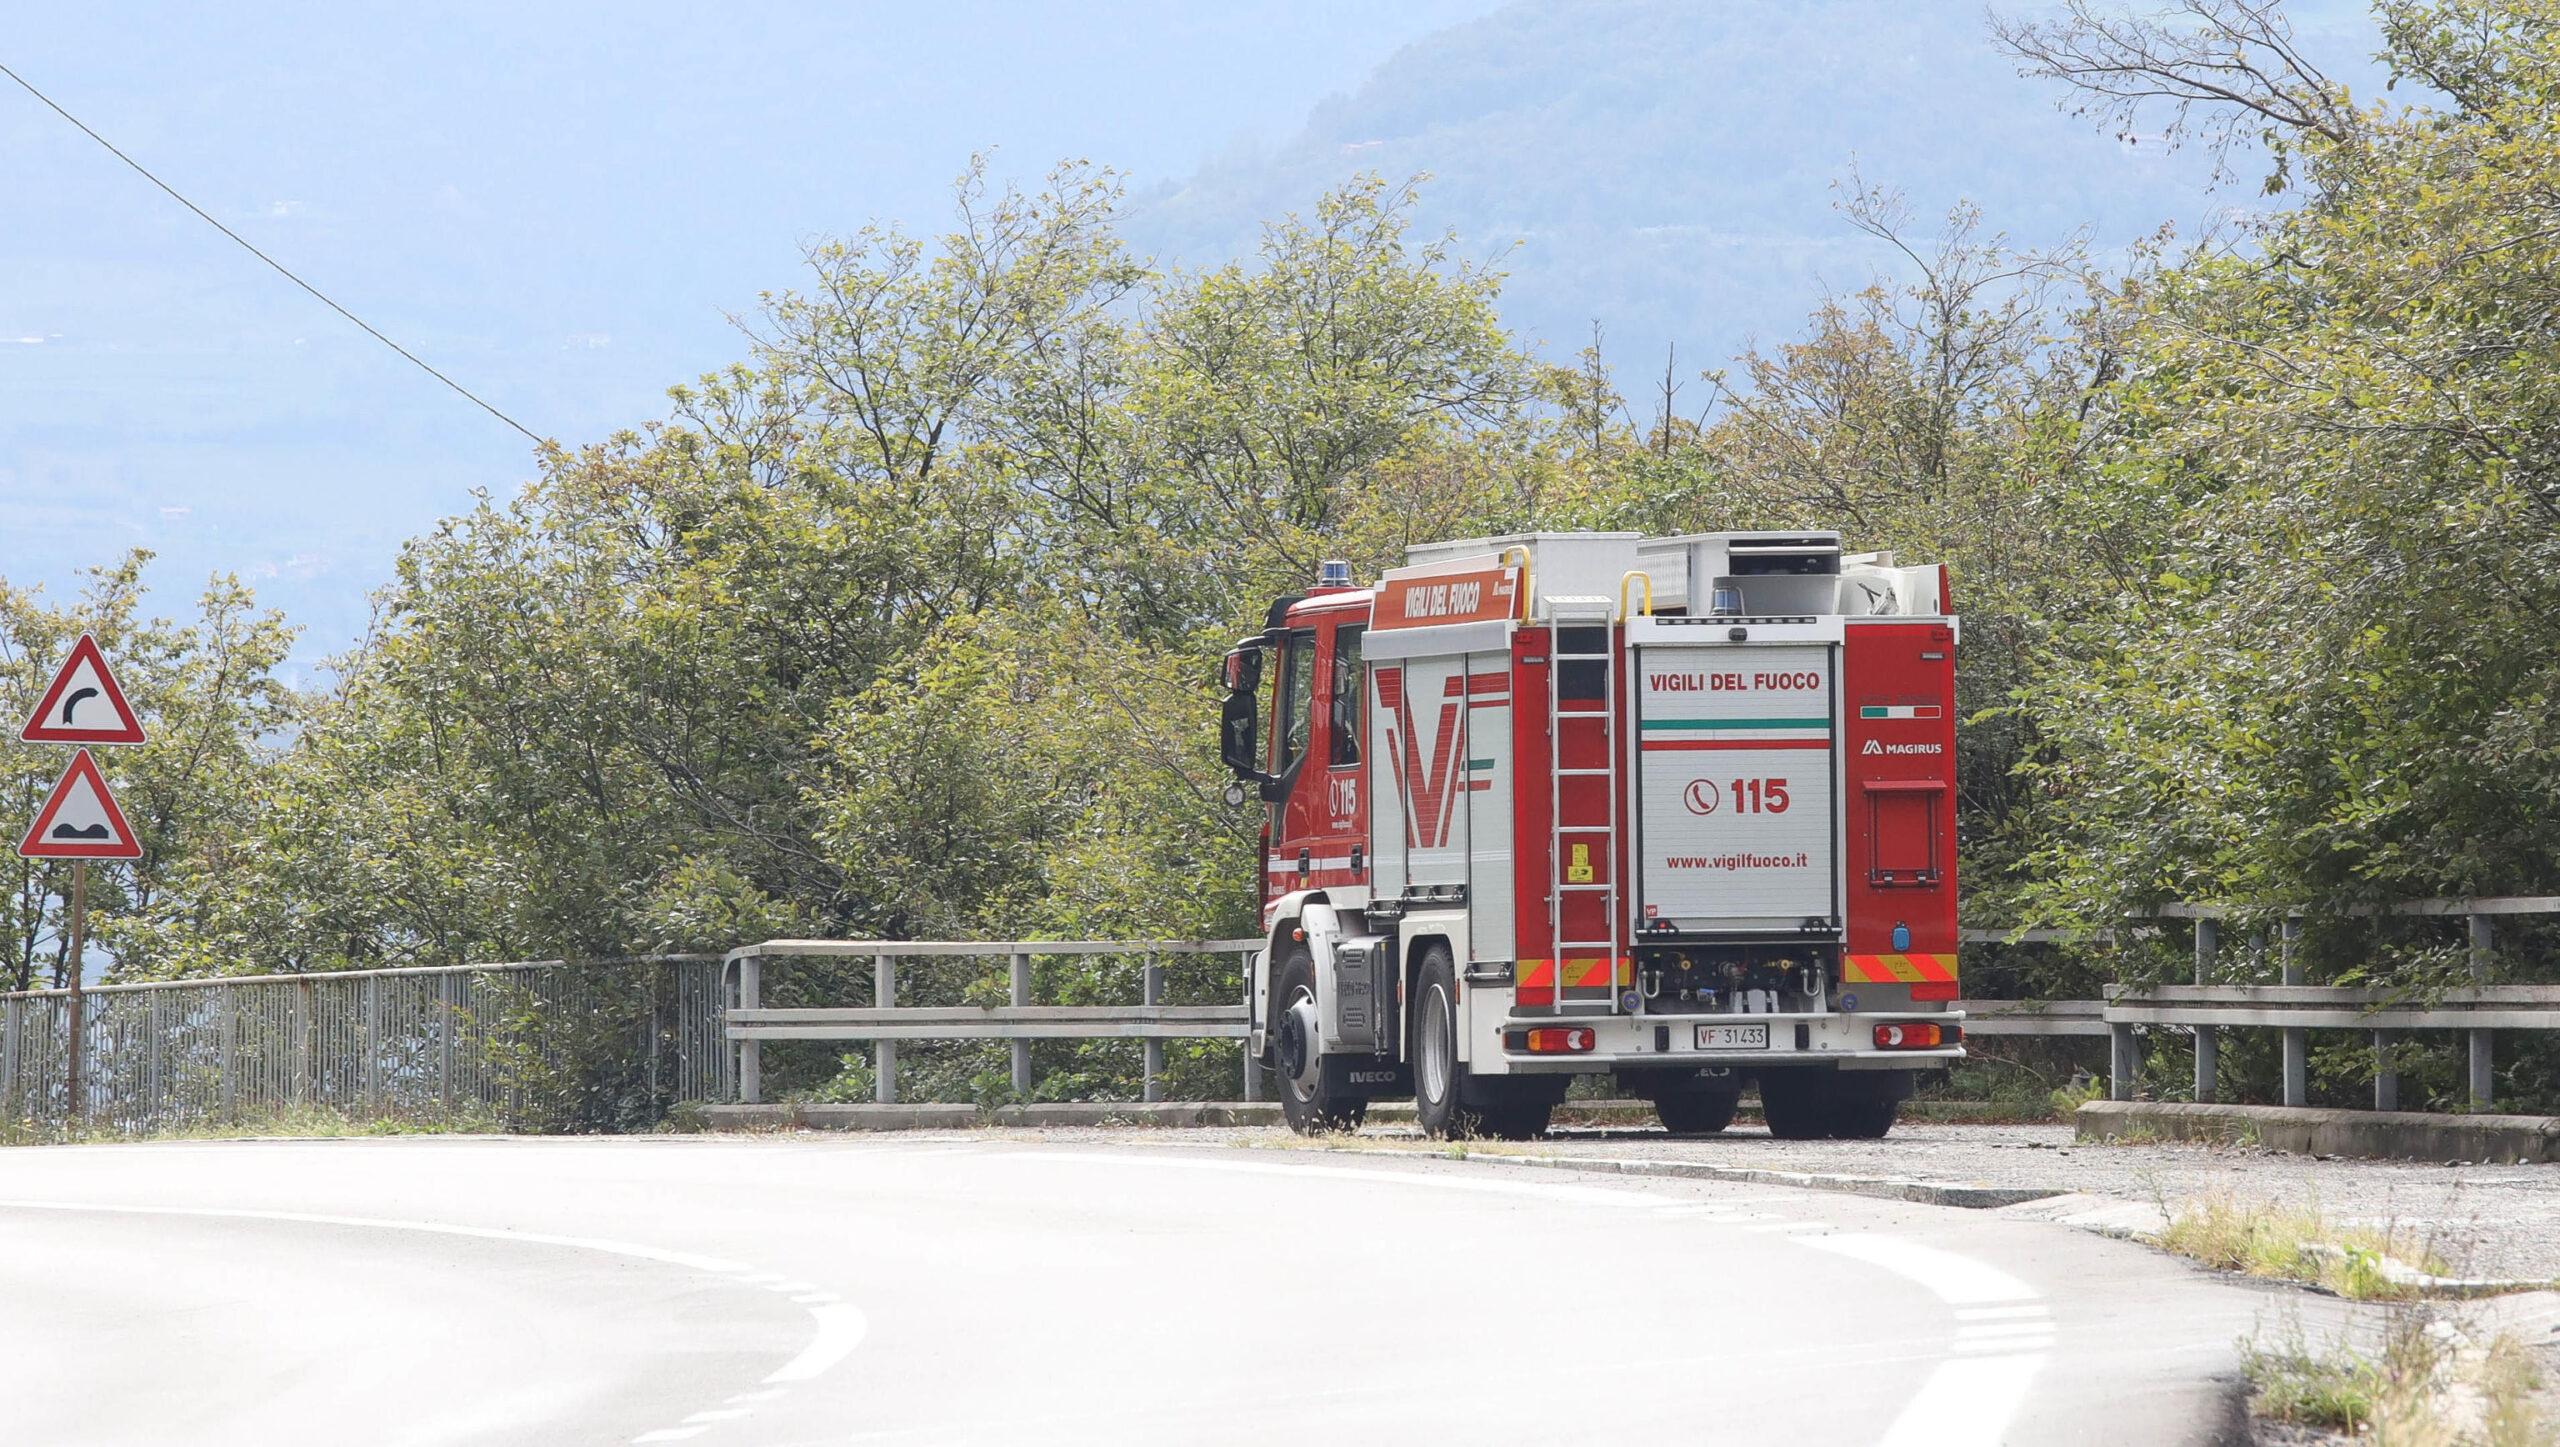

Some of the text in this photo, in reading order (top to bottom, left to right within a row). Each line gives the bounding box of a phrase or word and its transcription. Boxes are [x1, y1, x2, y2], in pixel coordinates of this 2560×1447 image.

[1405, 581, 1480, 618] VIGILI DEL FUOCO
[1650, 672, 1820, 691] VIGILI DEL FUOCO
[1886, 743, 1942, 754] MAGIRUS
[1340, 778, 1356, 815] 115
[1731, 778, 1790, 813] 115
[1667, 853, 1807, 871] www.vigilfuoco.it
[1700, 1028, 1764, 1044] VF 31433
[1350, 1071, 1396, 1083] IVECO
